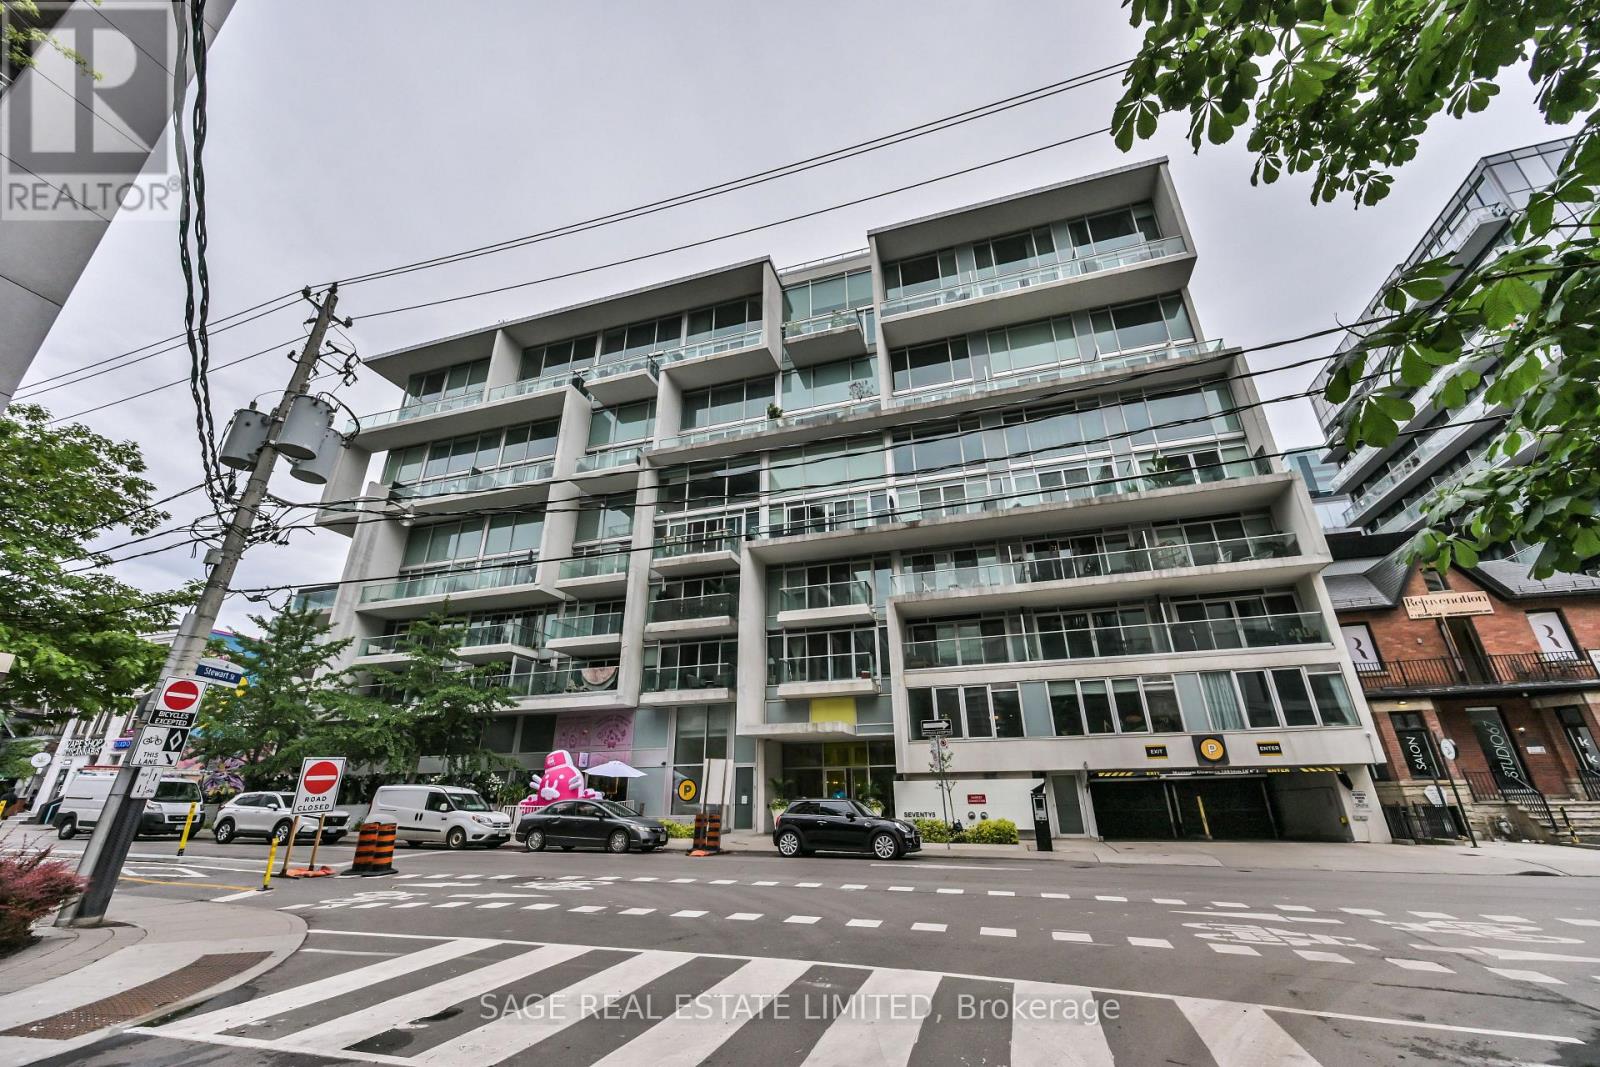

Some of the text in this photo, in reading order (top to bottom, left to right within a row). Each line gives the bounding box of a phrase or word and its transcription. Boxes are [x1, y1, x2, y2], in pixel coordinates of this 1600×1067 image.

[1405, 595, 1487, 613] Rejuvenation
[203, 667, 229, 680] Stewart
[158, 711, 189, 719] BICYCLES
[154, 719, 188, 727] EXCEPTED
[84, 738, 104, 748] SHOP
[1208, 744, 1217, 755] P
[1406, 736, 1427, 770] SALON
[684, 784, 693, 796] P
